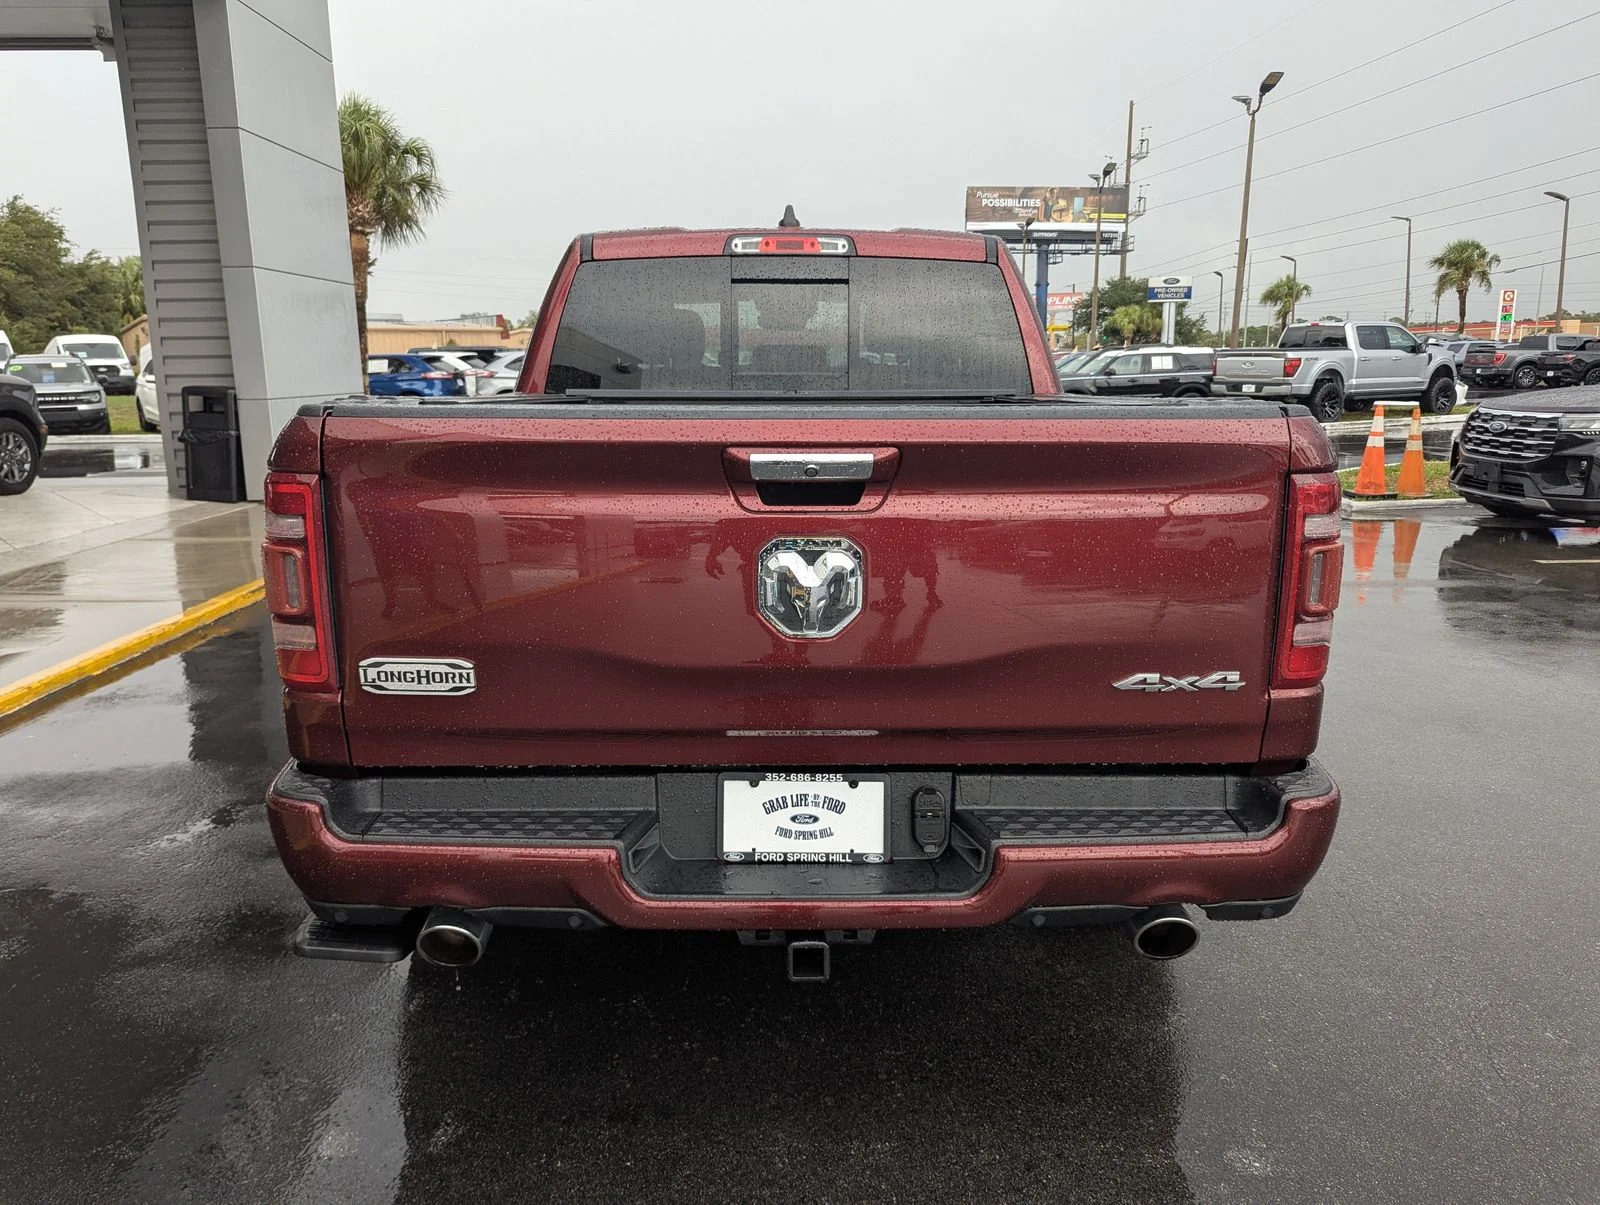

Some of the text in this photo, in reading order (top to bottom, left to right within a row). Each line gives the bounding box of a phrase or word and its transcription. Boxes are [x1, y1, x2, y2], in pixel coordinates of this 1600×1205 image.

[982, 198, 1041, 207] POSSIBILITIES
[765, 773, 844, 782] 352-686-8255
[762, 795, 789, 815] GRAB
[790, 793, 809, 808] LIFE
[821, 796, 847, 815] FORD
[794, 814, 815, 823] Ford
[774, 825, 835, 840] FORD SPRING HILL
[754, 852, 853, 863] FORD SPRING HILL
